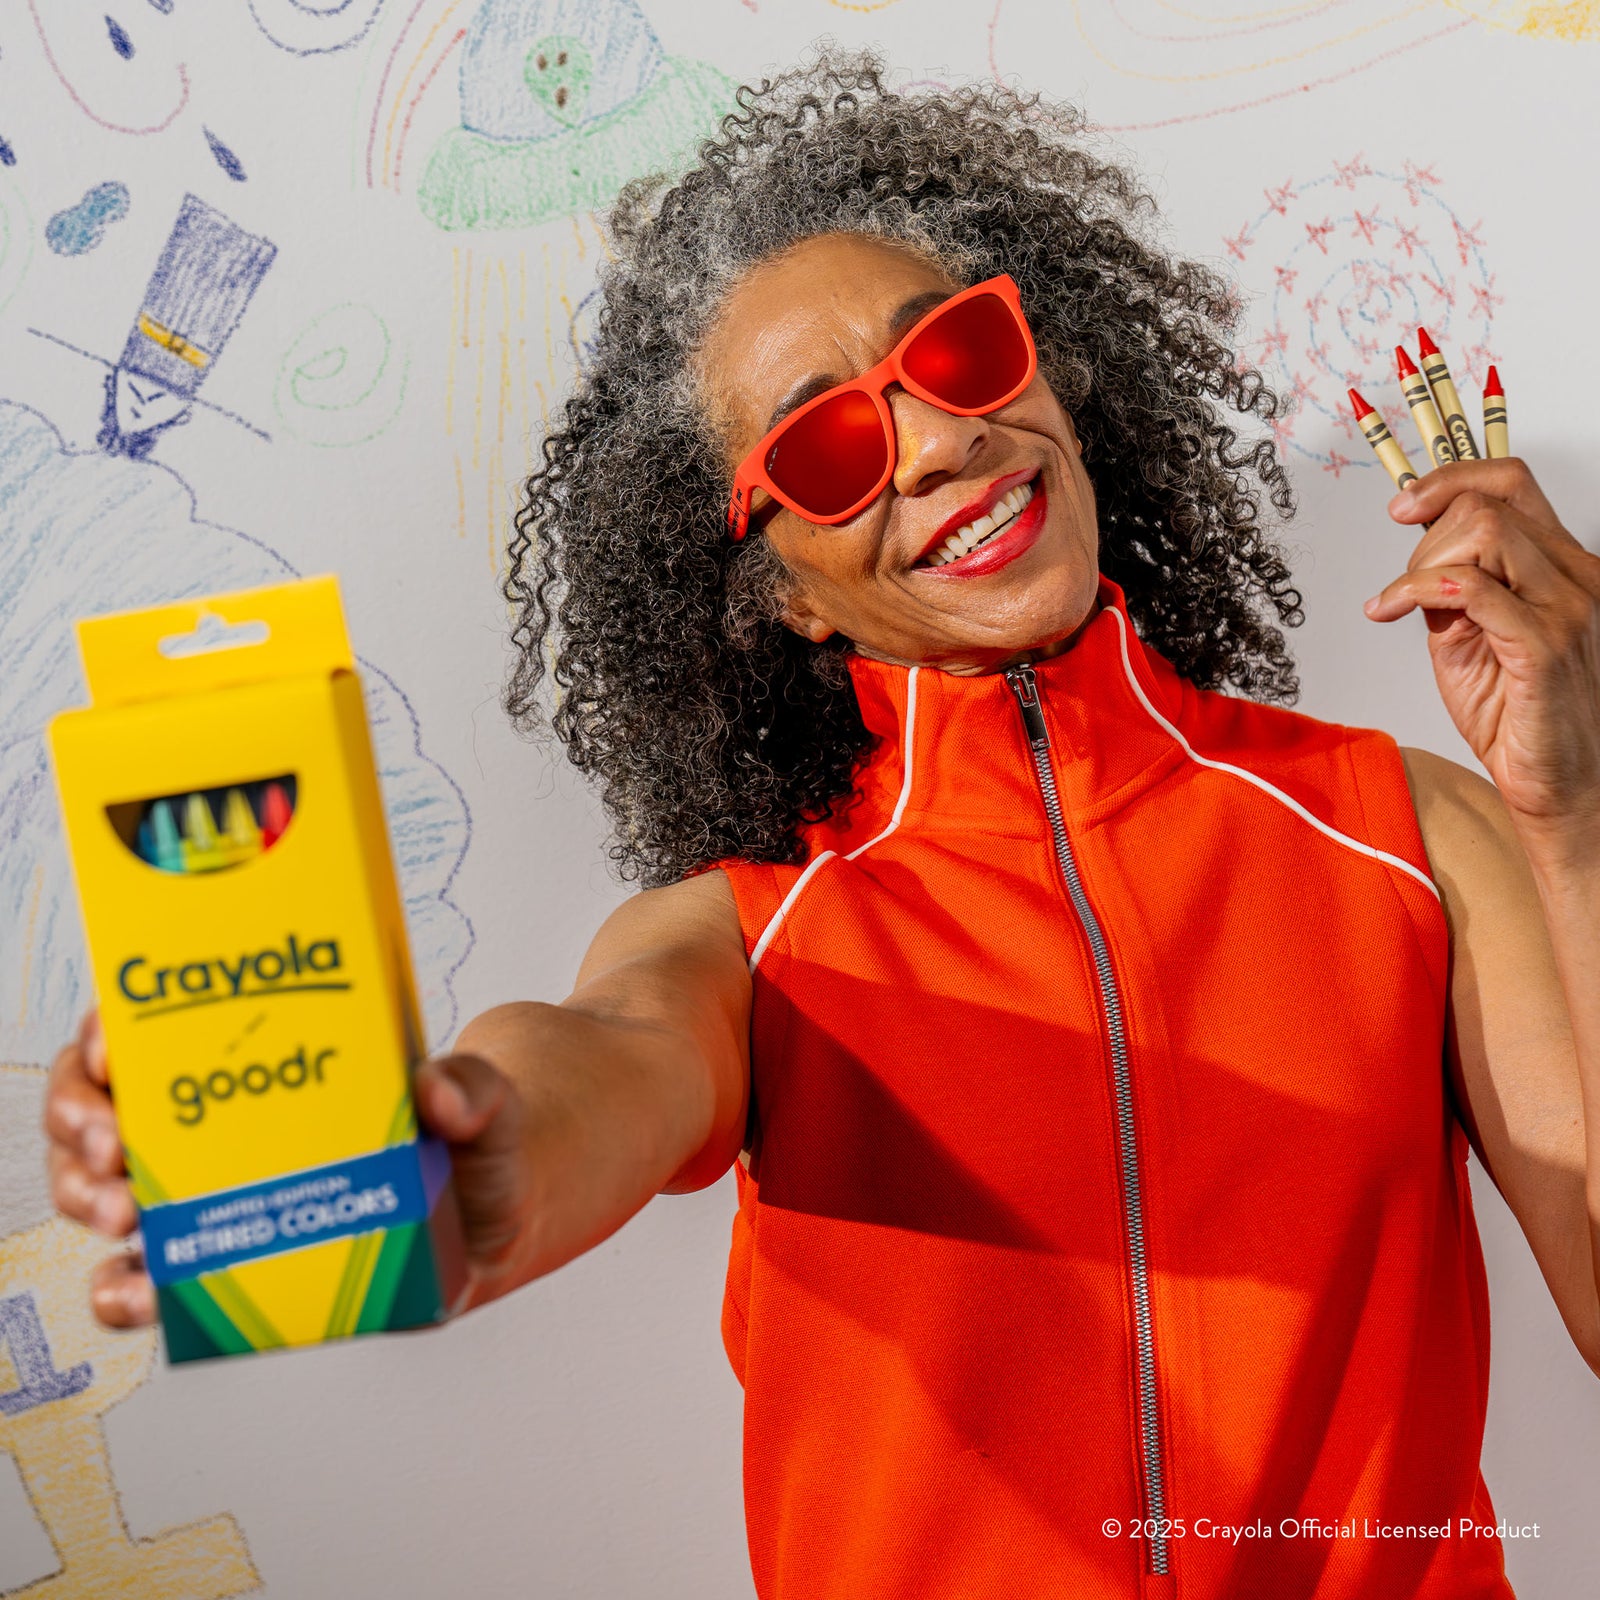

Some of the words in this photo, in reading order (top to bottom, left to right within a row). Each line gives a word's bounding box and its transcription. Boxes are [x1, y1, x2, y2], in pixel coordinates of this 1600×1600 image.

[117, 933, 342, 1003] Crayola
[170, 1045, 338, 1127] goodr
[163, 1213, 277, 1266] RETIRED
[277, 1182, 399, 1238] COLORS
